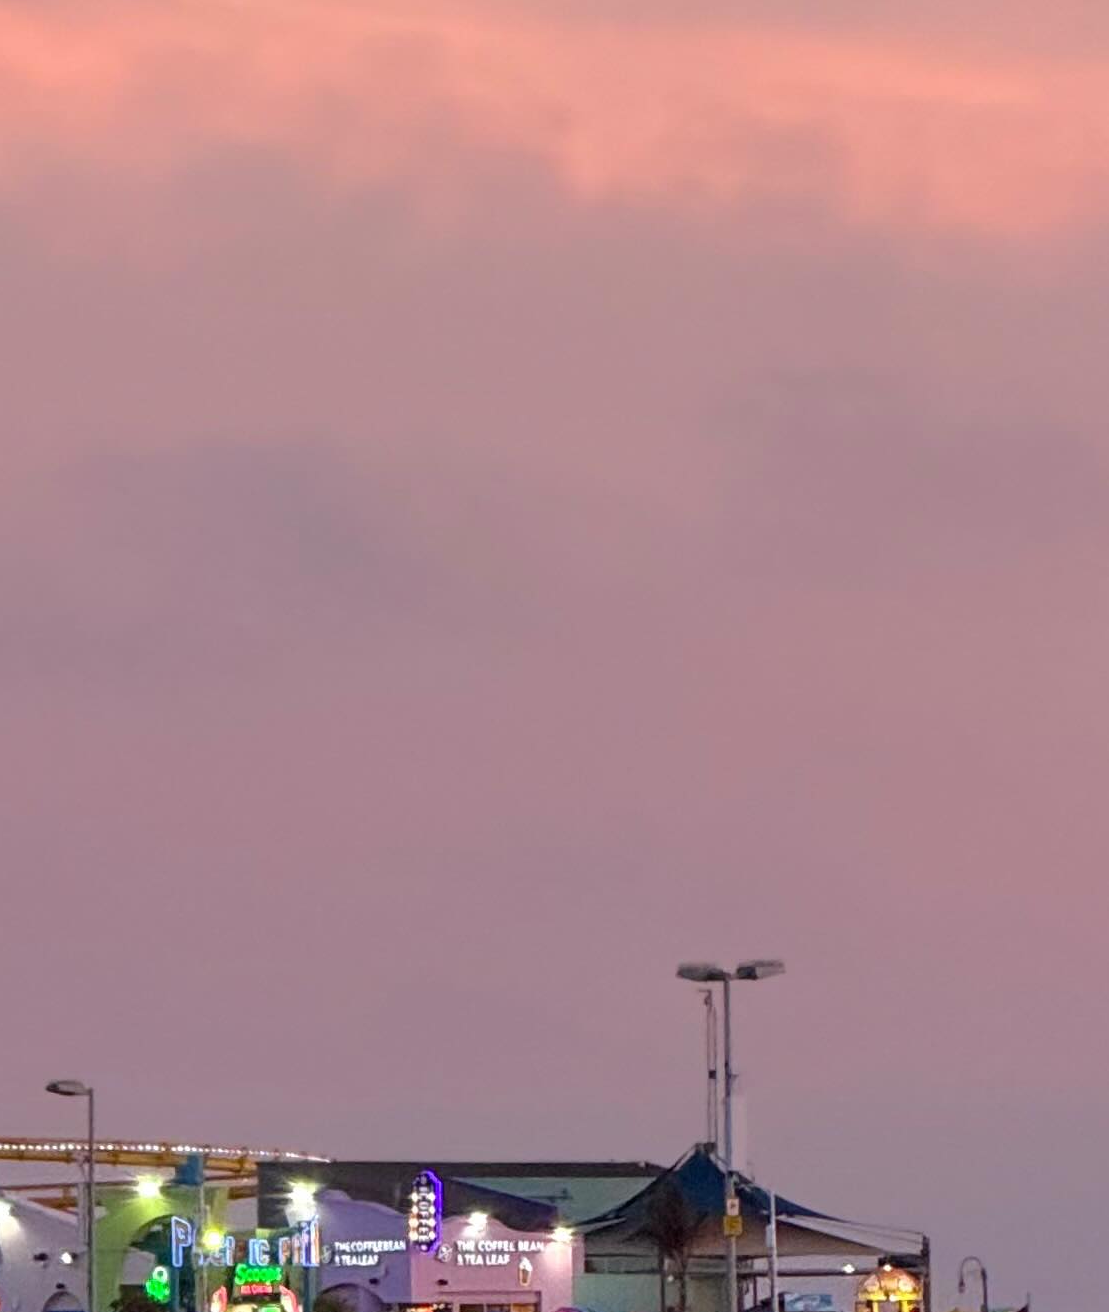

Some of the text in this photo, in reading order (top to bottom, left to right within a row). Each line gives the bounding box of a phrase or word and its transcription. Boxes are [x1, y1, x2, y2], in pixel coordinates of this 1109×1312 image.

[334, 1241, 350, 1252] THE
[456, 1240, 545, 1252] THE COFFEE BEAN
[464, 1254, 483, 1266] TEA
[486, 1253, 510, 1266] LEAF
